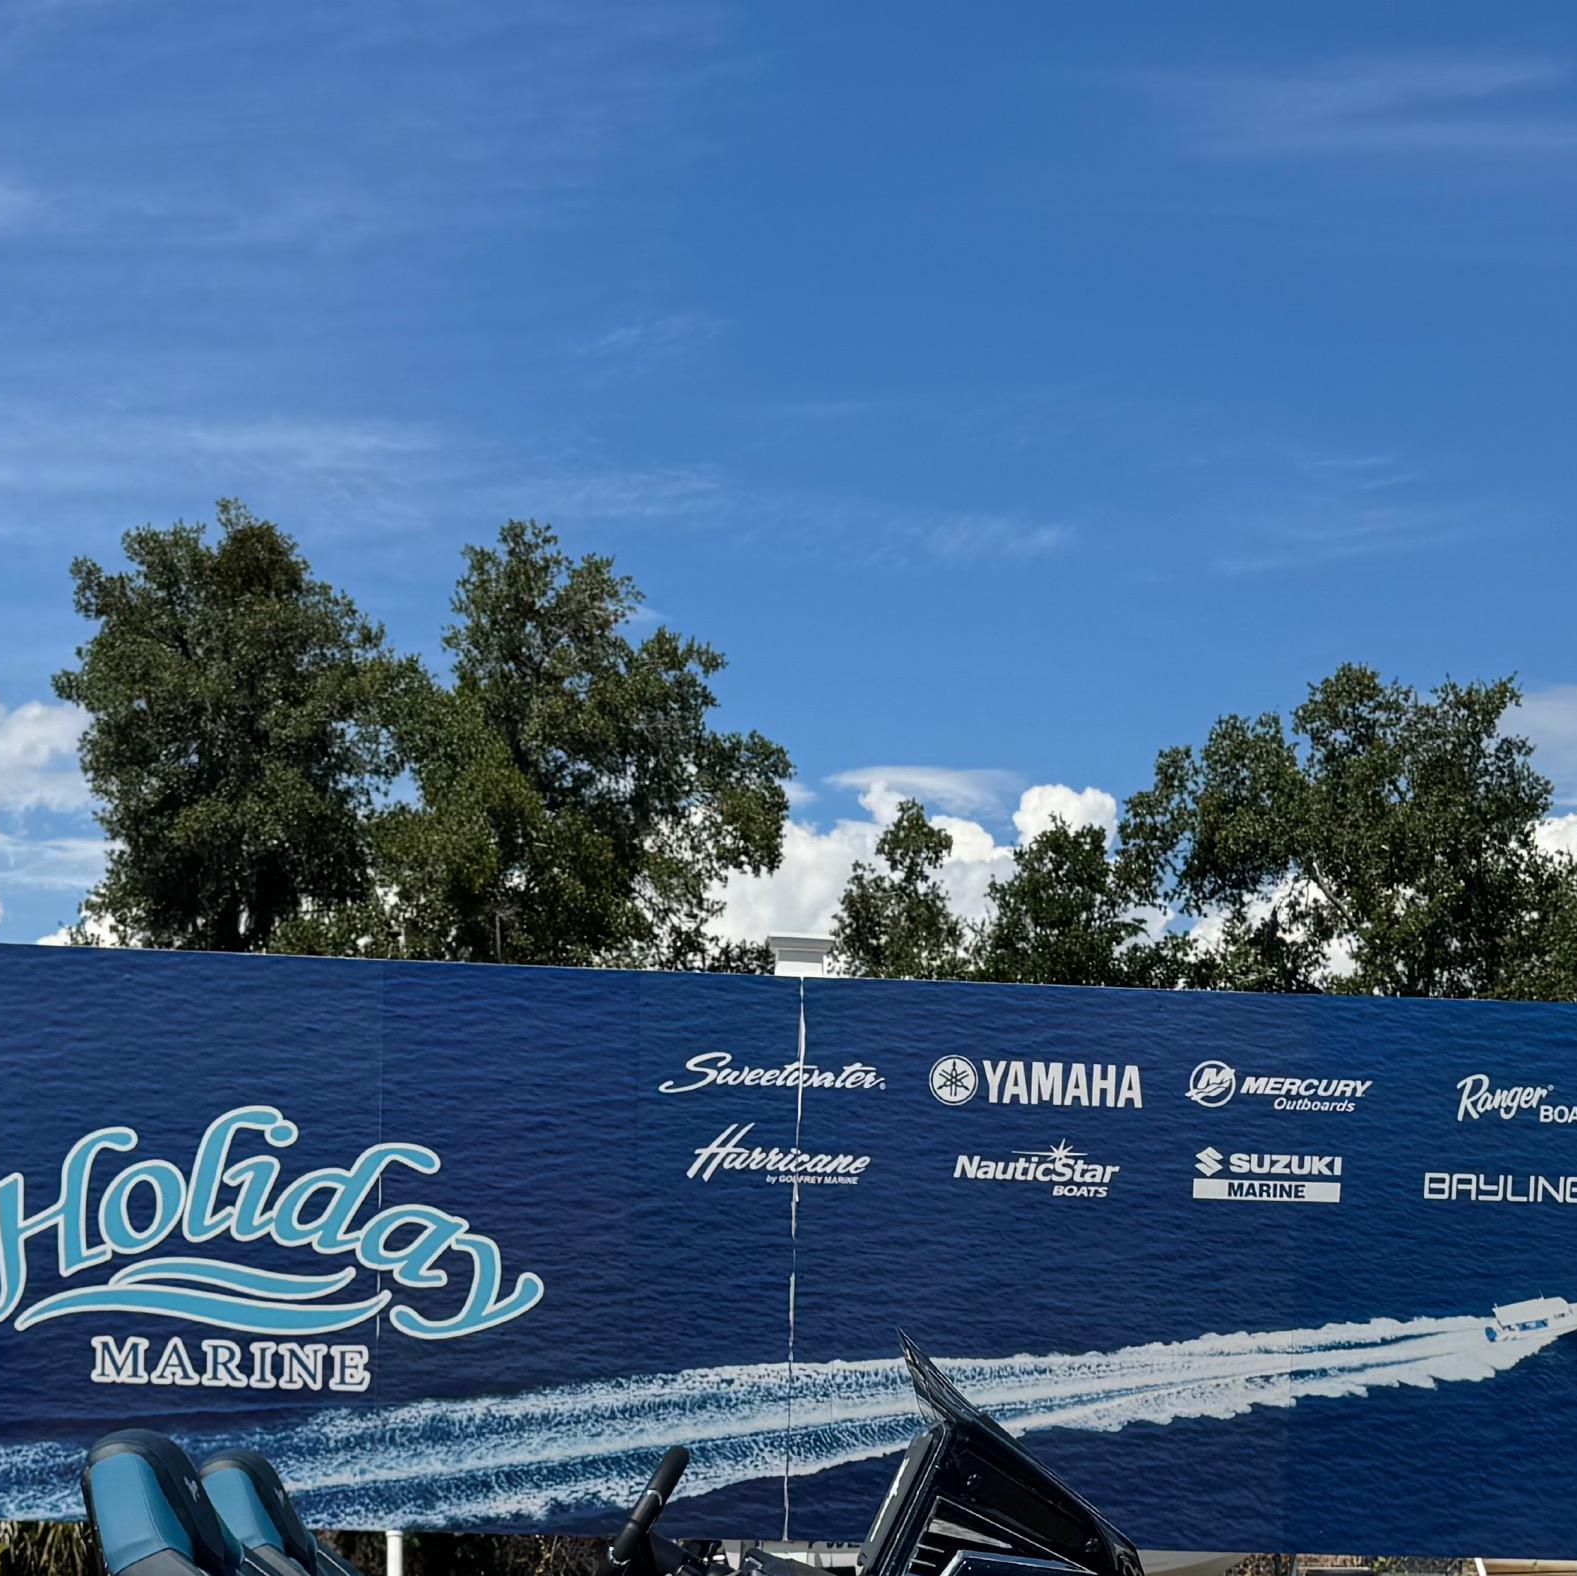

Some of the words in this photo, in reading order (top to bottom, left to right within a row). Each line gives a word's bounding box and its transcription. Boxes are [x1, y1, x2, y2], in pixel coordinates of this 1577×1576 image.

[658, 1051, 886, 1094] Sweetwater
[982, 1059, 1143, 1109] YAMAHA
[1240, 1076, 1373, 1098] MERCURY
[1456, 1073, 1548, 1122] Ranger
[1273, 1097, 1356, 1113] Outboards
[686, 1122, 872, 1182] Hurricane
[1229, 1153, 1343, 1176] SUZUKI
[766, 1174, 777, 1184] by
[953, 1154, 1121, 1184] NauticStar
[1052, 1185, 1109, 1198] BOATS
[1227, 1182, 1306, 1199] MARINE
[90, 1336, 371, 1392] MARINE
